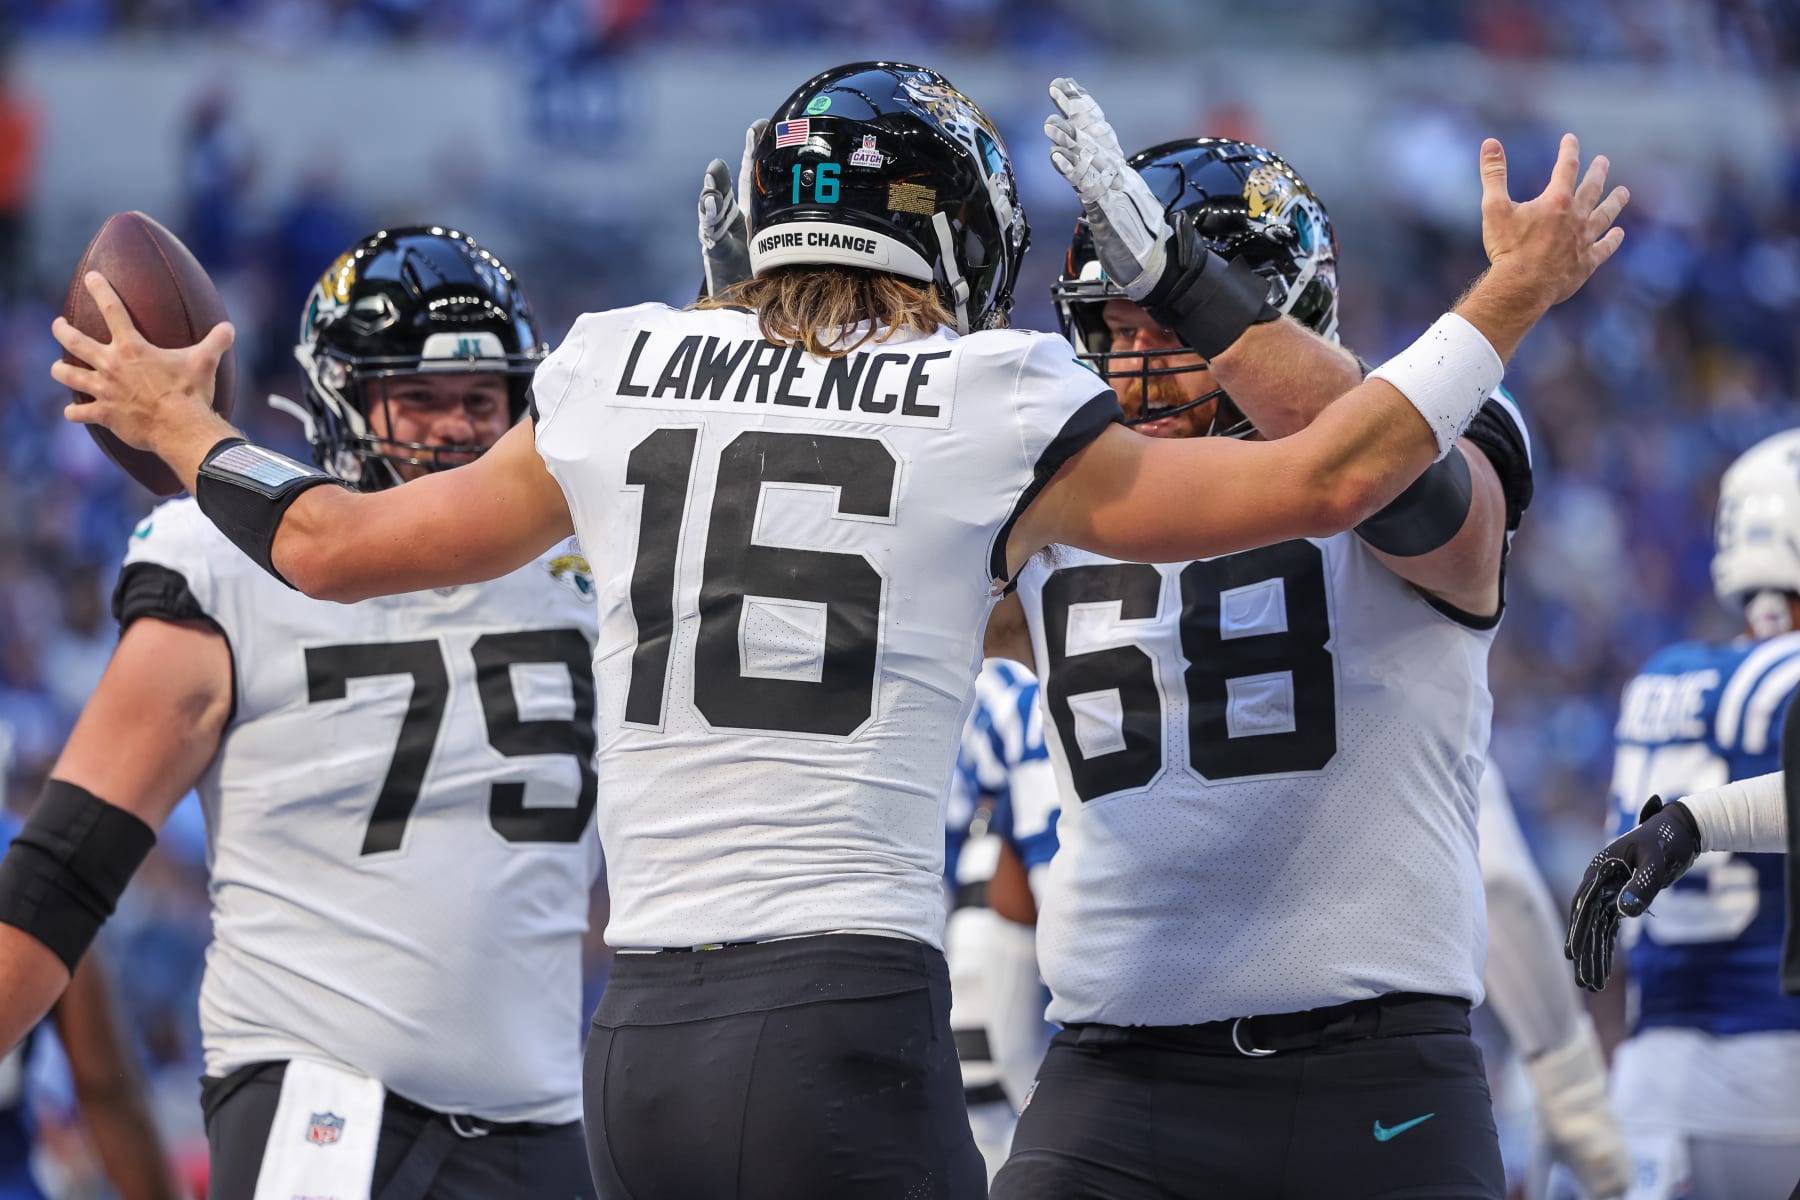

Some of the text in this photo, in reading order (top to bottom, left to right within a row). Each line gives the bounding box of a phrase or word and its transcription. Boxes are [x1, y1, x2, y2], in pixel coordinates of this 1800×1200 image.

[792, 163, 841, 204] 16
[853, 153, 882, 163] CATCH
[758, 232, 877, 254] INSPIRE CHANGE
[616, 330, 951, 418] LAWRENCE
[625, 427, 897, 736] 16
[1042, 538, 1337, 803] 68
[304, 628, 598, 857] 79
